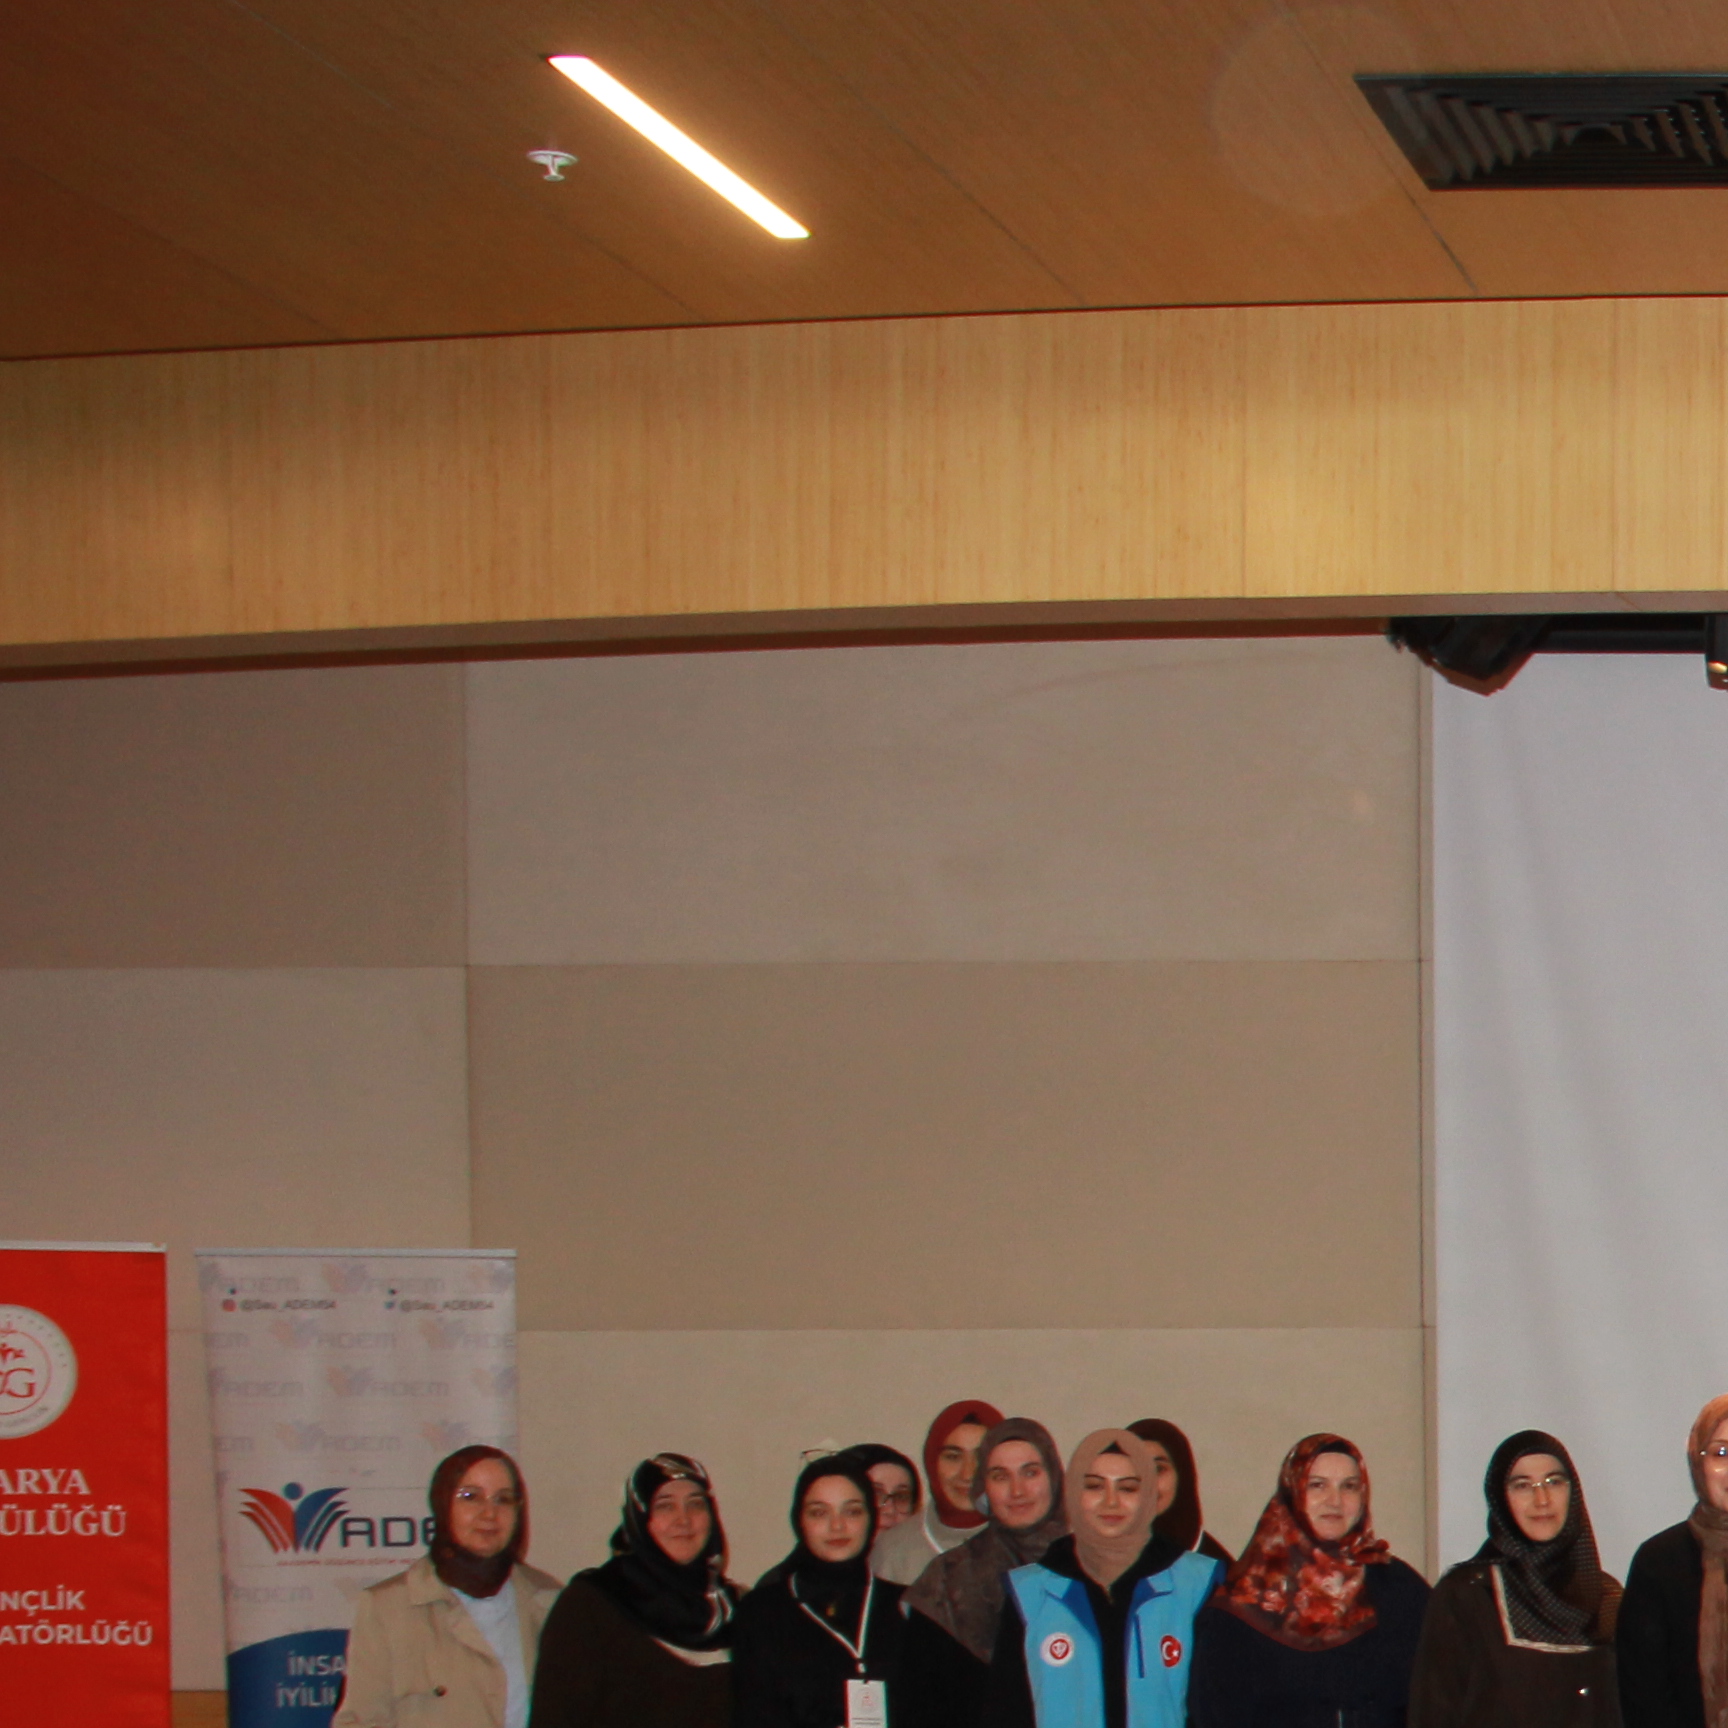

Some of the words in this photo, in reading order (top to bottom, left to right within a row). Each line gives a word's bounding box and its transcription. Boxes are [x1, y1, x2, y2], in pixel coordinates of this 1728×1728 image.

[0, 1503, 128, 1537] ÜLÜĞÜ
[0, 1584, 87, 1617] NÇLİK
[0, 1619, 155, 1647] ATÖRLÜĞÜ
